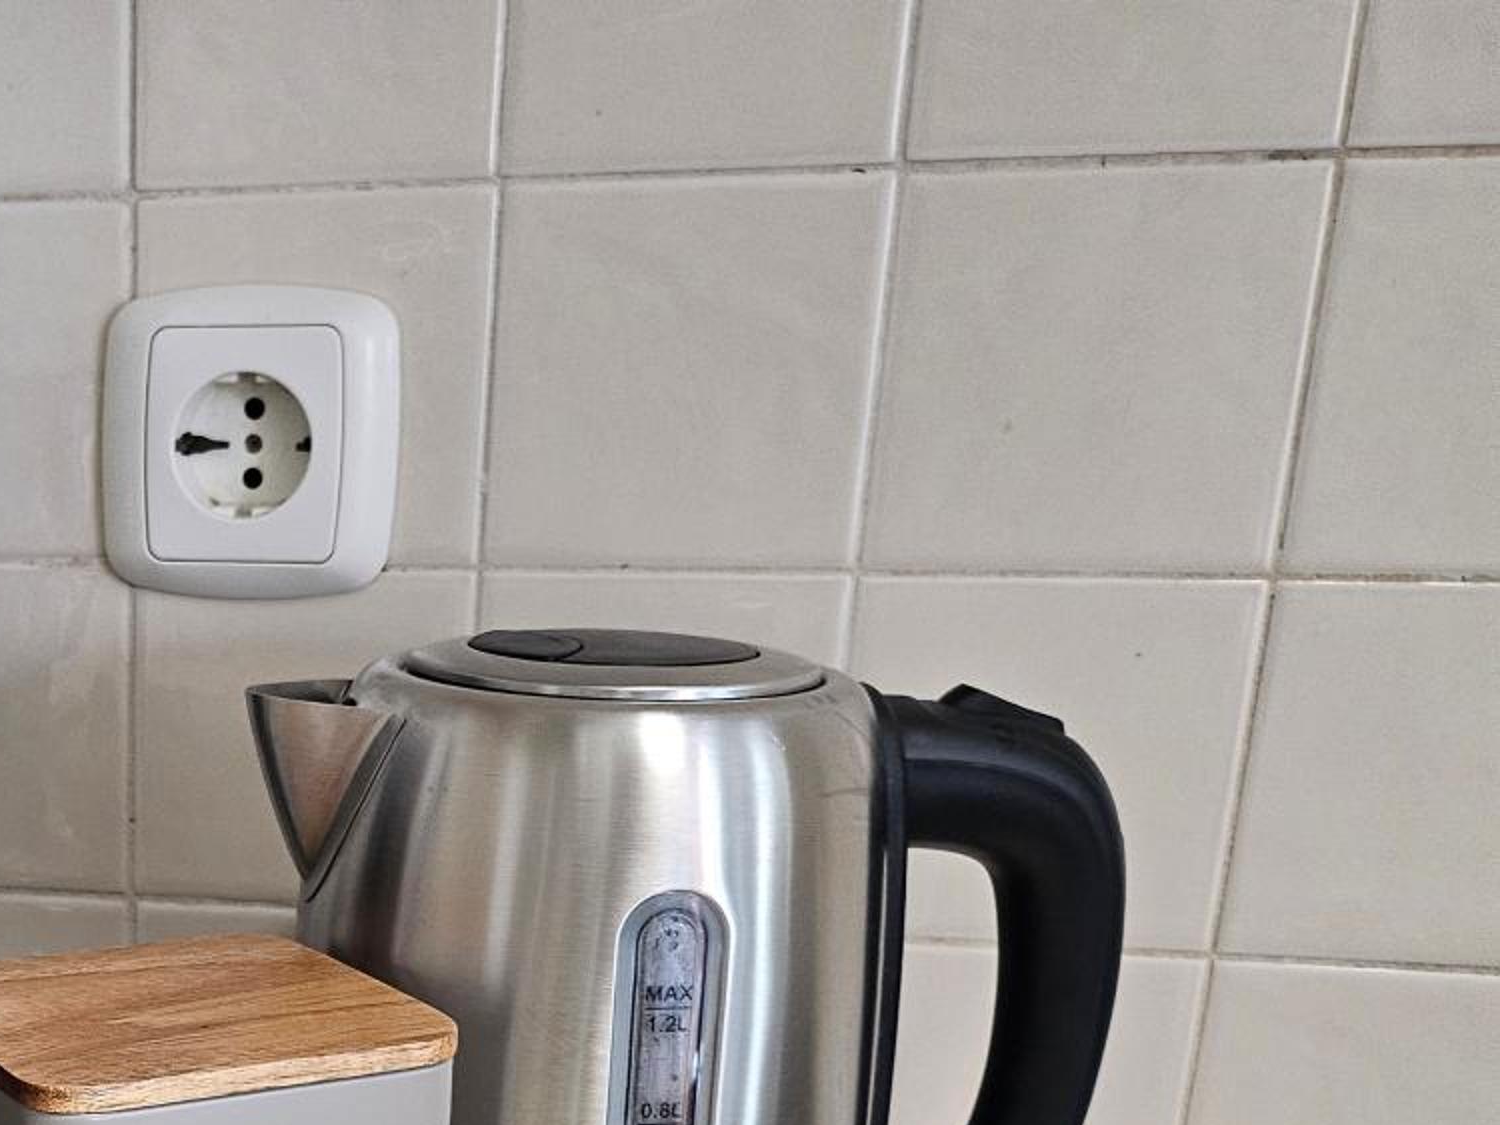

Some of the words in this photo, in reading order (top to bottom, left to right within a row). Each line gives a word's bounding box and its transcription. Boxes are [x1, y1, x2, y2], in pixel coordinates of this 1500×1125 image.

[645, 984, 695, 1002] MAX
[646, 1014, 688, 1034] 1.2L
[640, 1102, 682, 1120] 0.8L
